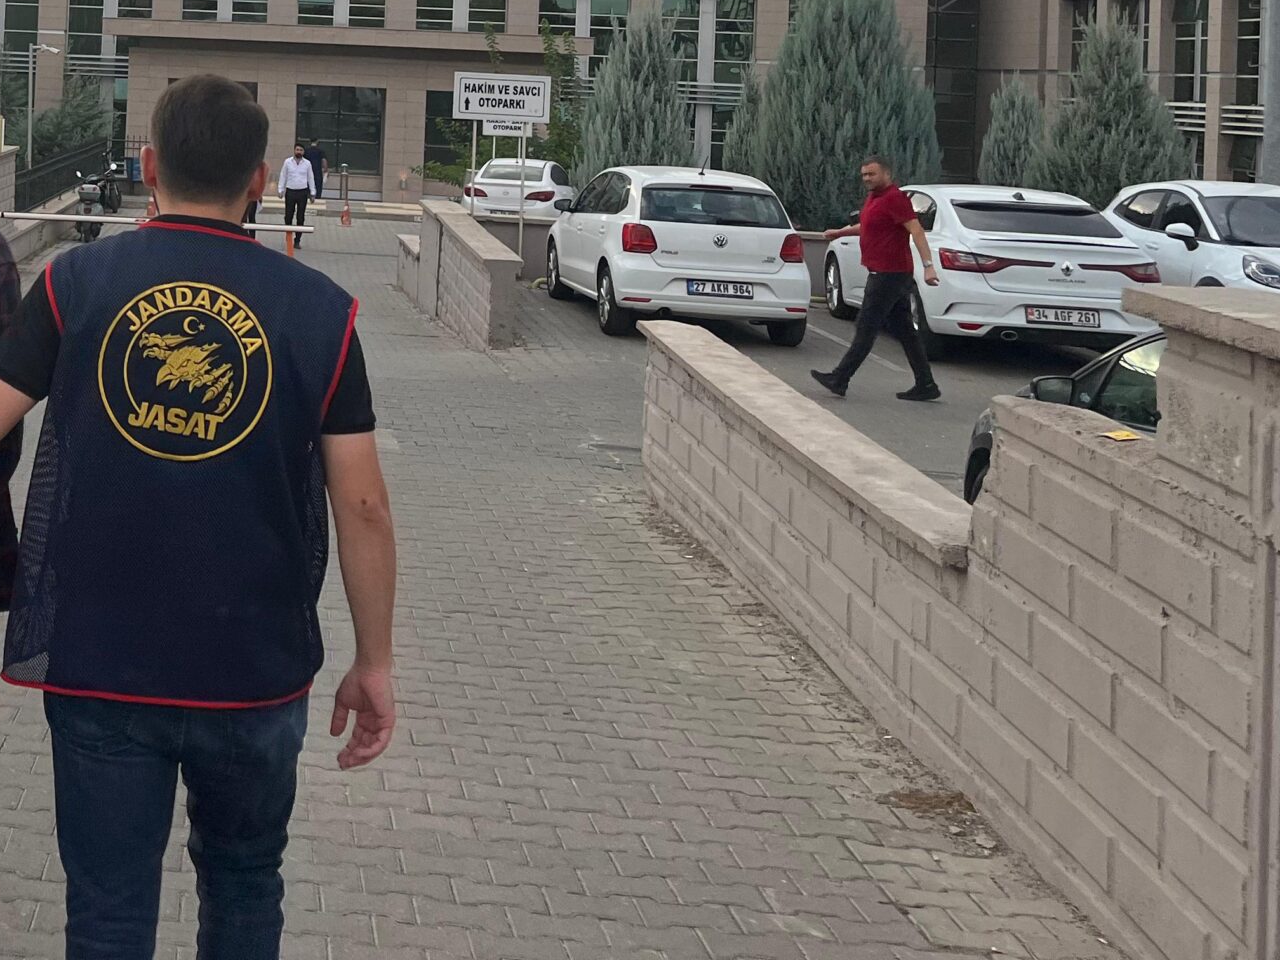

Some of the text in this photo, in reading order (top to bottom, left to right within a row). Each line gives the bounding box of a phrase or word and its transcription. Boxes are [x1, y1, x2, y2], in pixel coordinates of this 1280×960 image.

[464, 82, 541, 97] HAKİM VE SAVCI
[478, 97, 525, 110] OTOPARKI
[694, 281, 751, 296] 27 AKH 964
[126, 287, 263, 357] JANDARMA
[1035, 309, 1096, 324] 34 AGF 261
[127, 401, 224, 441] JASAT
